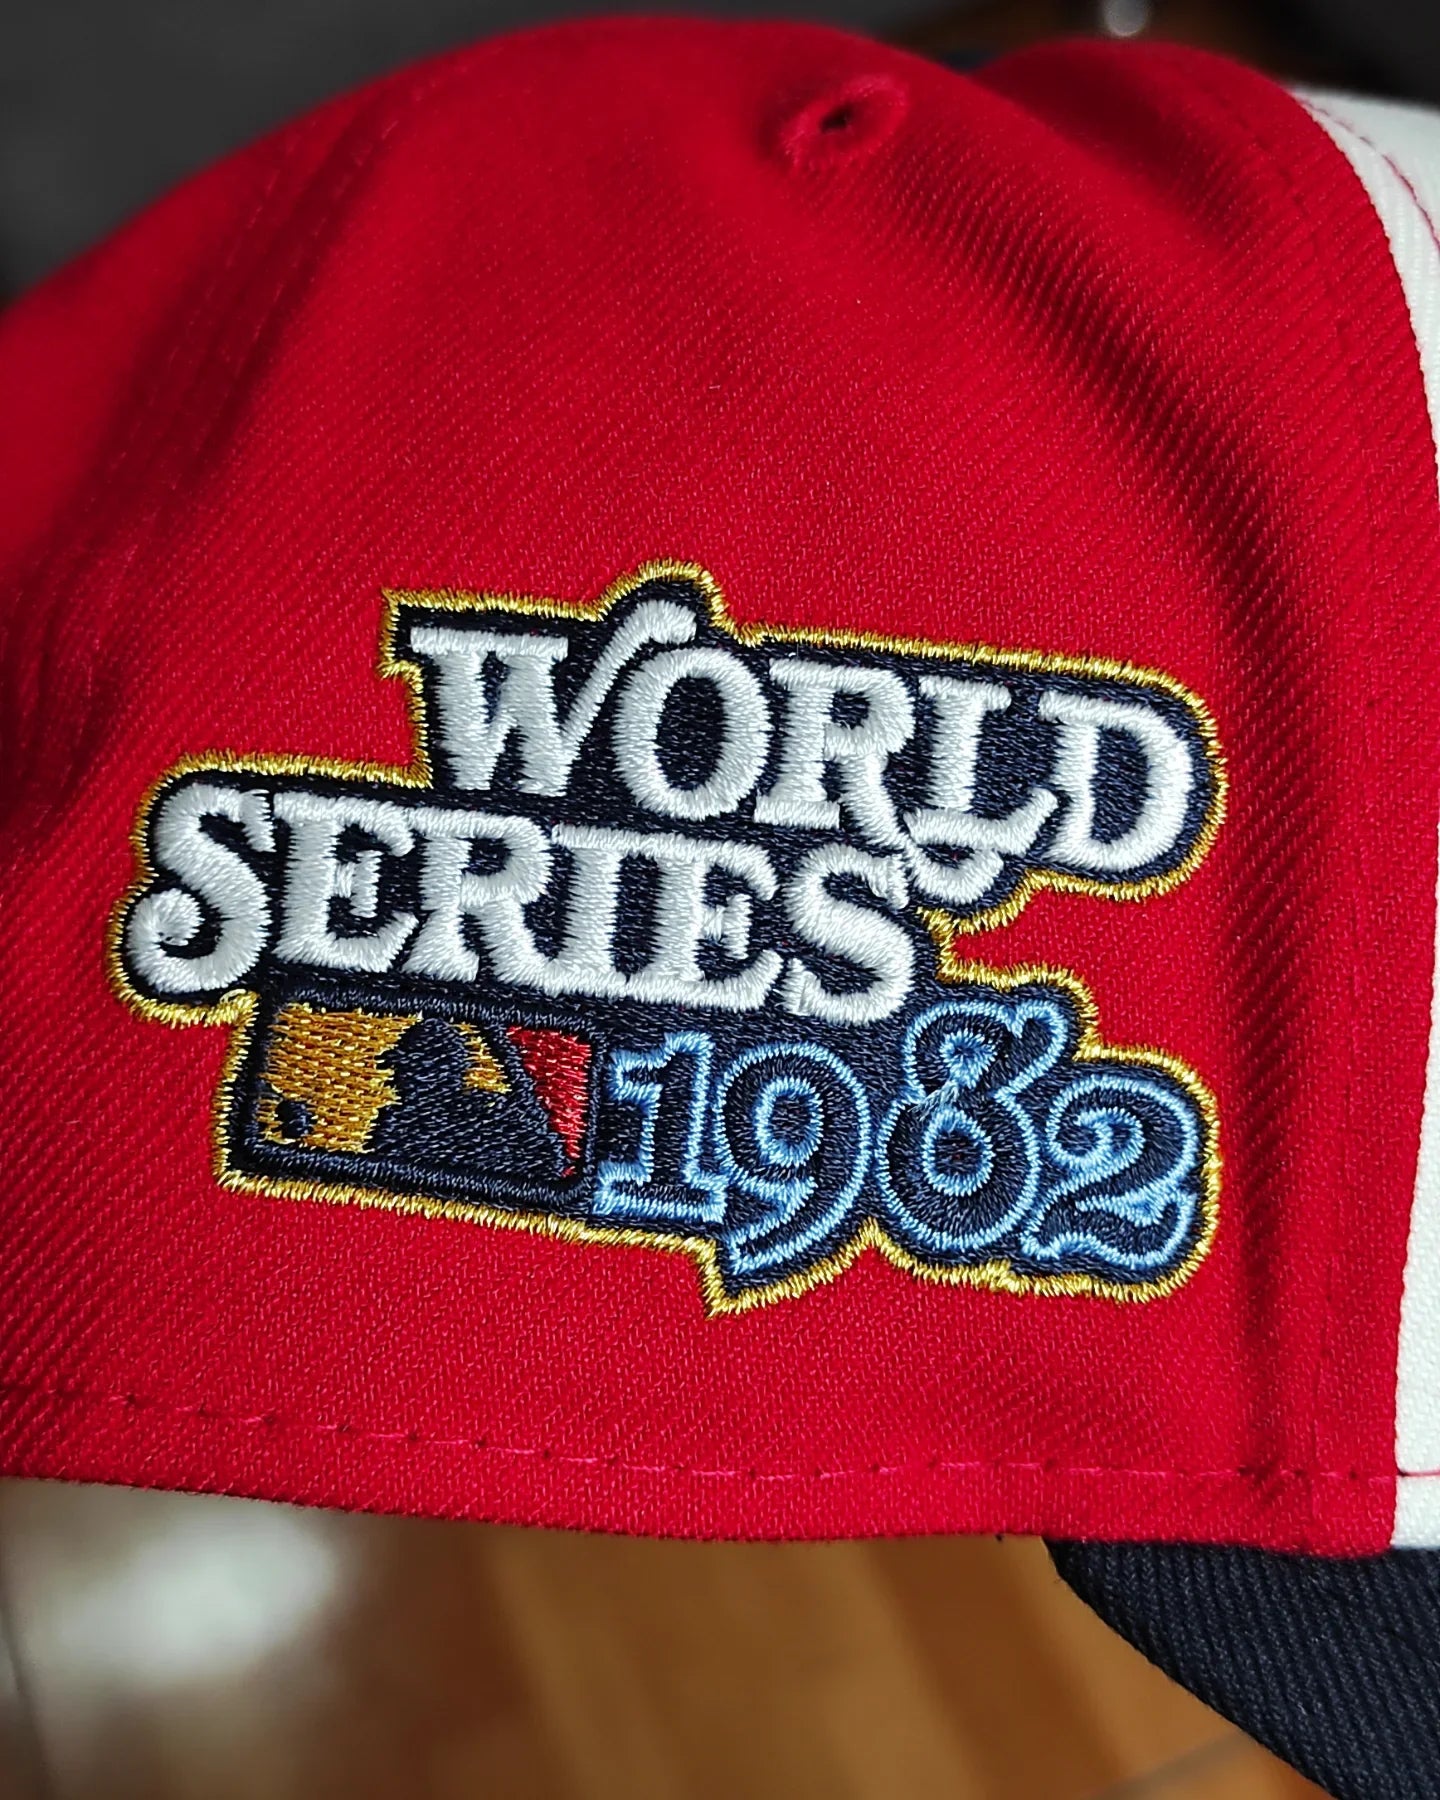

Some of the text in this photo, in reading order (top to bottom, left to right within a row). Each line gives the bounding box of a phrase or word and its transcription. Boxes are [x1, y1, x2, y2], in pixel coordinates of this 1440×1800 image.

[410, 600, 1194, 907] WORLD
[122, 780, 918, 1024] SERIES
[591, 1000, 1196, 1276] 1982
